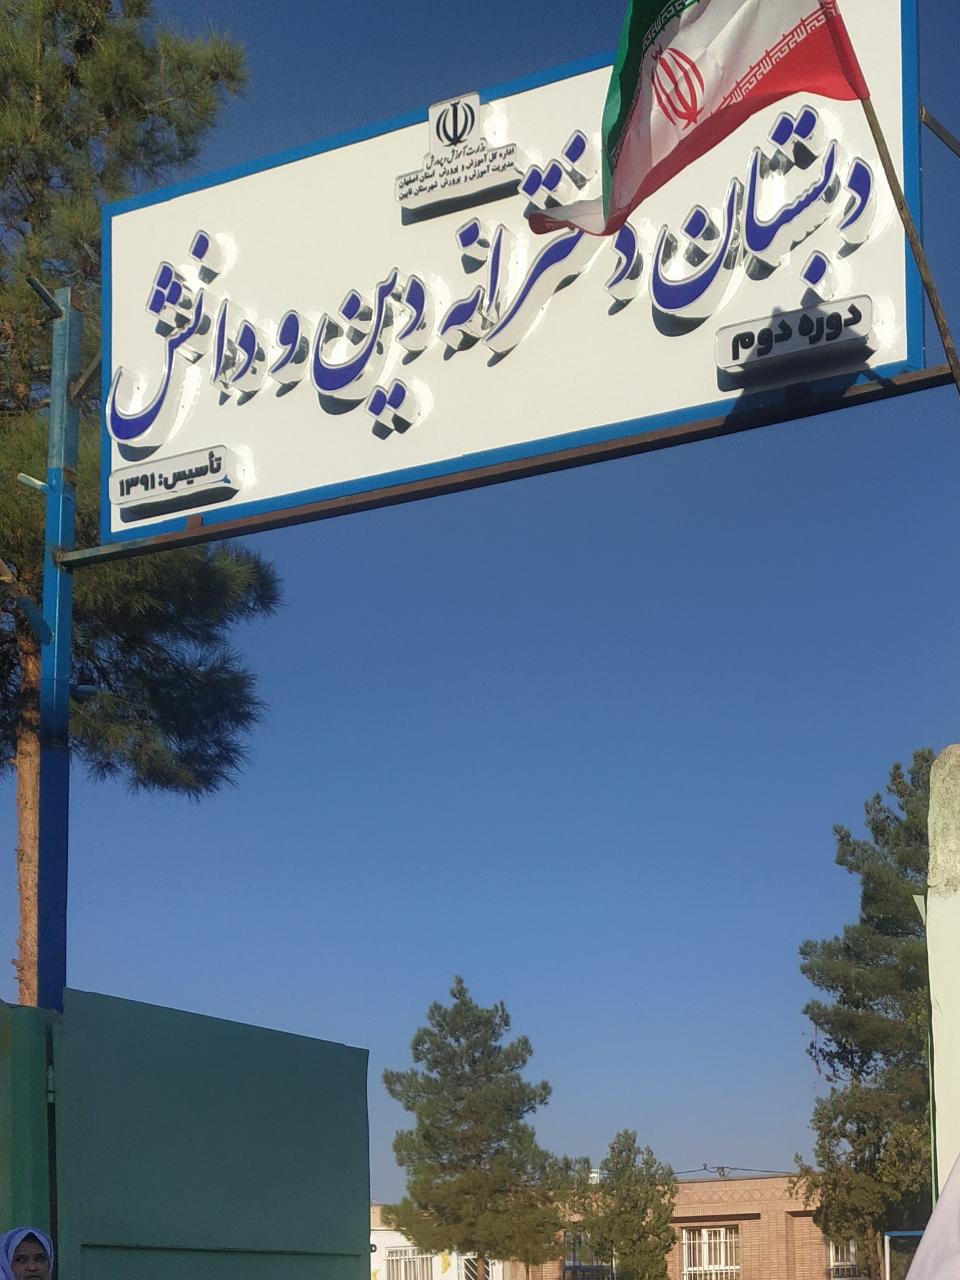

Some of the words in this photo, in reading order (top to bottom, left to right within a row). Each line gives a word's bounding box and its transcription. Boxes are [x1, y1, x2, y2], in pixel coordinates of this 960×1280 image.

[488, 151, 498, 163] کل
[499, 147, 515, 160] اداره
[465, 154, 488, 170] آموزش
[492, 161, 514, 173] مدیریت
[420, 170, 436, 182] استان
[439, 165, 459, 178] پرورش
[469, 165, 490, 180] آموزش
[399, 174, 418, 188] اصفهان
[414, 180, 438, 196] شهرستان
[440, 175, 461, 188] پرورش
[649, 105, 875, 311] دبستان
[437, 129, 638, 343] دترانه
[798, 303, 862, 345] دوره
[105, 231, 258, 444] دانش
[268, 310, 301, 375] و
[309, 267, 426, 416] دین
[731, 318, 793, 361] دوم
[158, 451, 223, 490] تأسیس:
[118, 472, 156, 497] ۱۳۹۱
